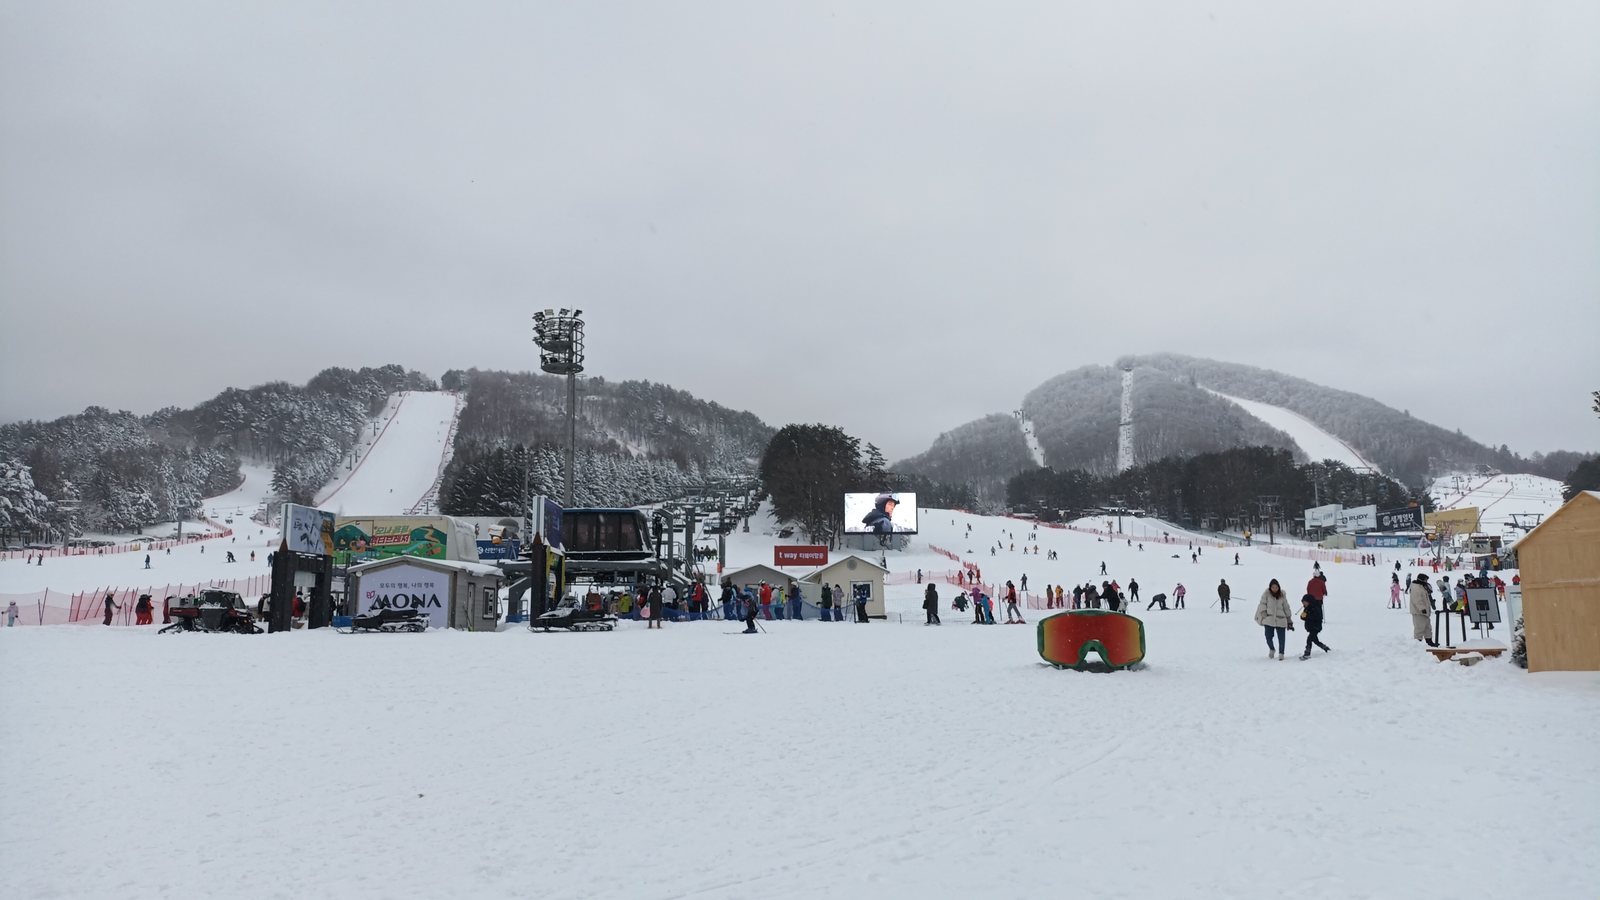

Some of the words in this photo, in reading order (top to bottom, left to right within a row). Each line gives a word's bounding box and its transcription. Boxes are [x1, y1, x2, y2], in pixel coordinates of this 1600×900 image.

[1348, 513, 1369, 521] RUDY
[1391, 513, 1414, 523] 세계일보
[784, 552, 798, 560] way
[397, 582, 410, 590] 행복,
[370, 593, 442, 609] MONA
